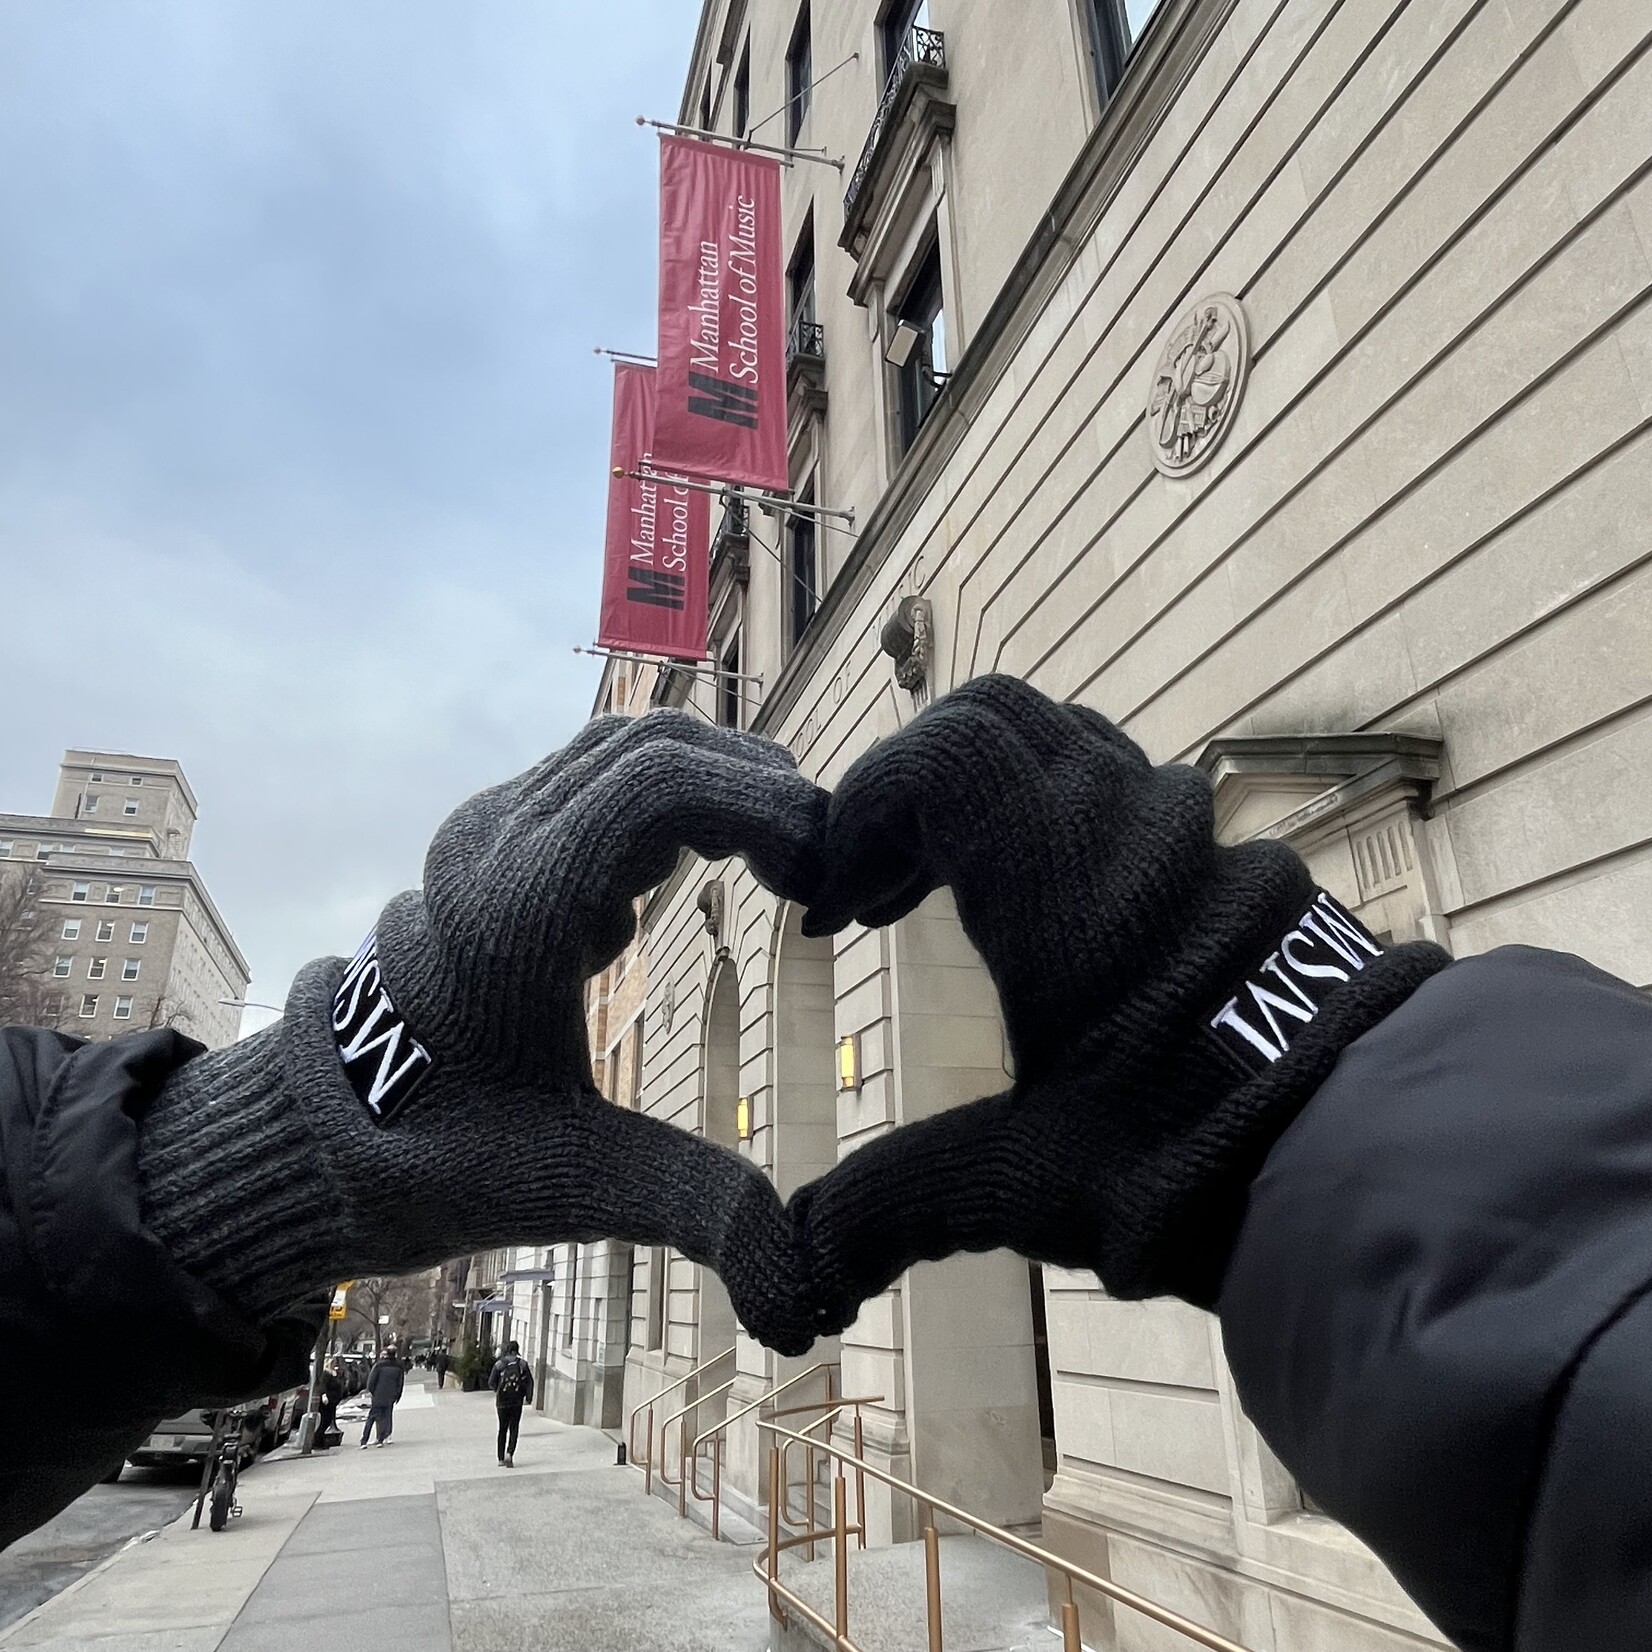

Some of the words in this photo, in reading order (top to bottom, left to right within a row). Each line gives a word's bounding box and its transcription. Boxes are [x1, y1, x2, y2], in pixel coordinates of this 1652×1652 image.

[728, 195, 757, 266] Music
[687, 240, 719, 374] Manhattan
[728, 260, 757, 294] of
[728, 293, 759, 384] School
[630, 452, 657, 566] Manhatan
[661, 498, 688, 572] School
[1210, 892, 1385, 1063] MSM
